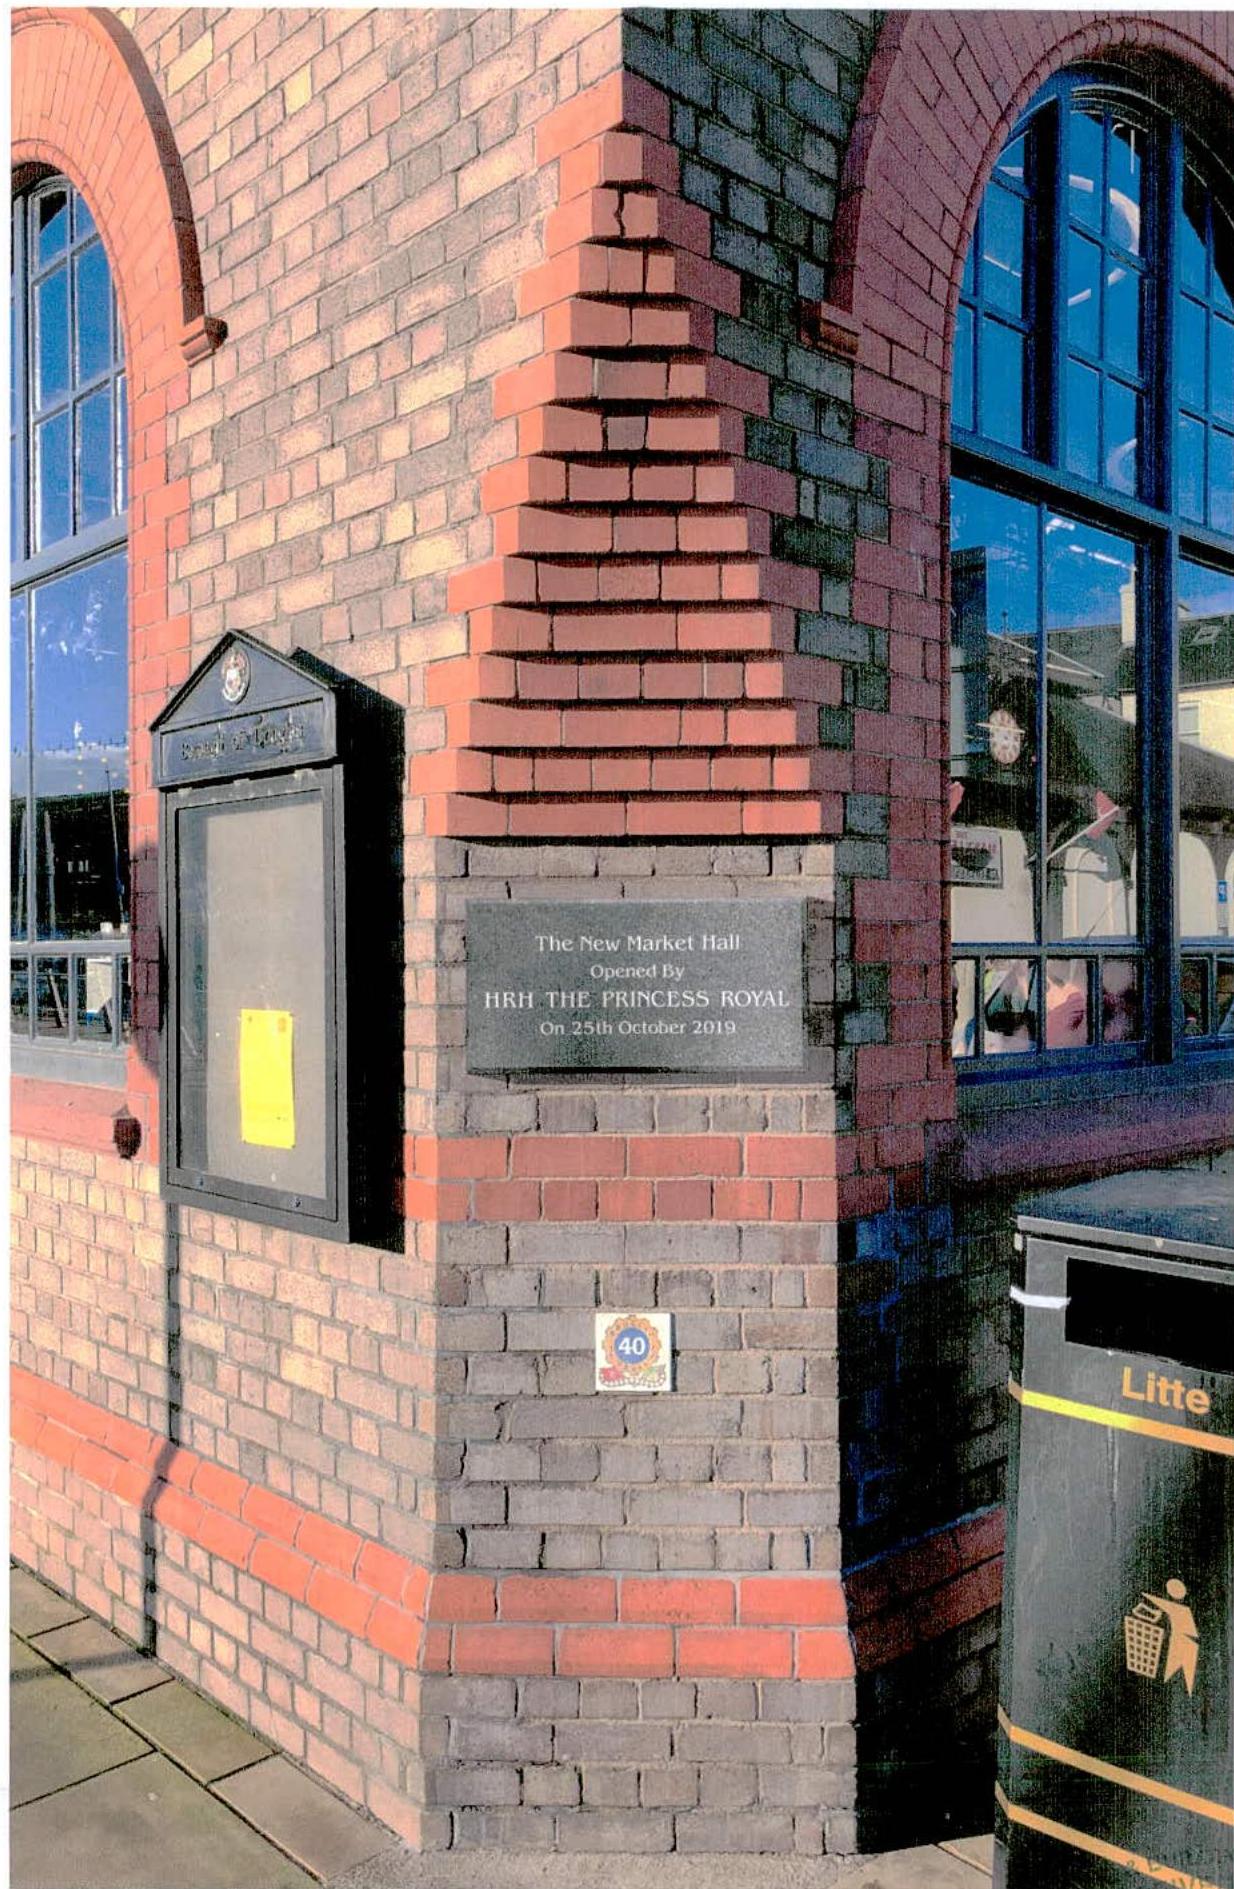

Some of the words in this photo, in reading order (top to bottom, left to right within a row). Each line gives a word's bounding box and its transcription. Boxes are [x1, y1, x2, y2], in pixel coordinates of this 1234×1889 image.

[535, 935, 573, 951] The
[580, 935, 620, 951] New
[627, 935, 693, 951] Market
[702, 934, 741, 951] Hall
[590, 964, 657, 982] Opened
[662, 964, 685, 982] By
[485, 991, 534, 1009] HRH
[545, 991, 591, 1008] THE
[602, 990, 710, 1008] PRINCESS
[721, 990, 790, 1008] ROYAL
[540, 1021, 565, 1036] On
[572, 1021, 613, 1036] 25th
[618, 1020, 686, 1036] October
[692, 1020, 736, 1036] 2019
[618, 1336, 646, 1356] 40
[1121, 1365, 1211, 1416] Litte
